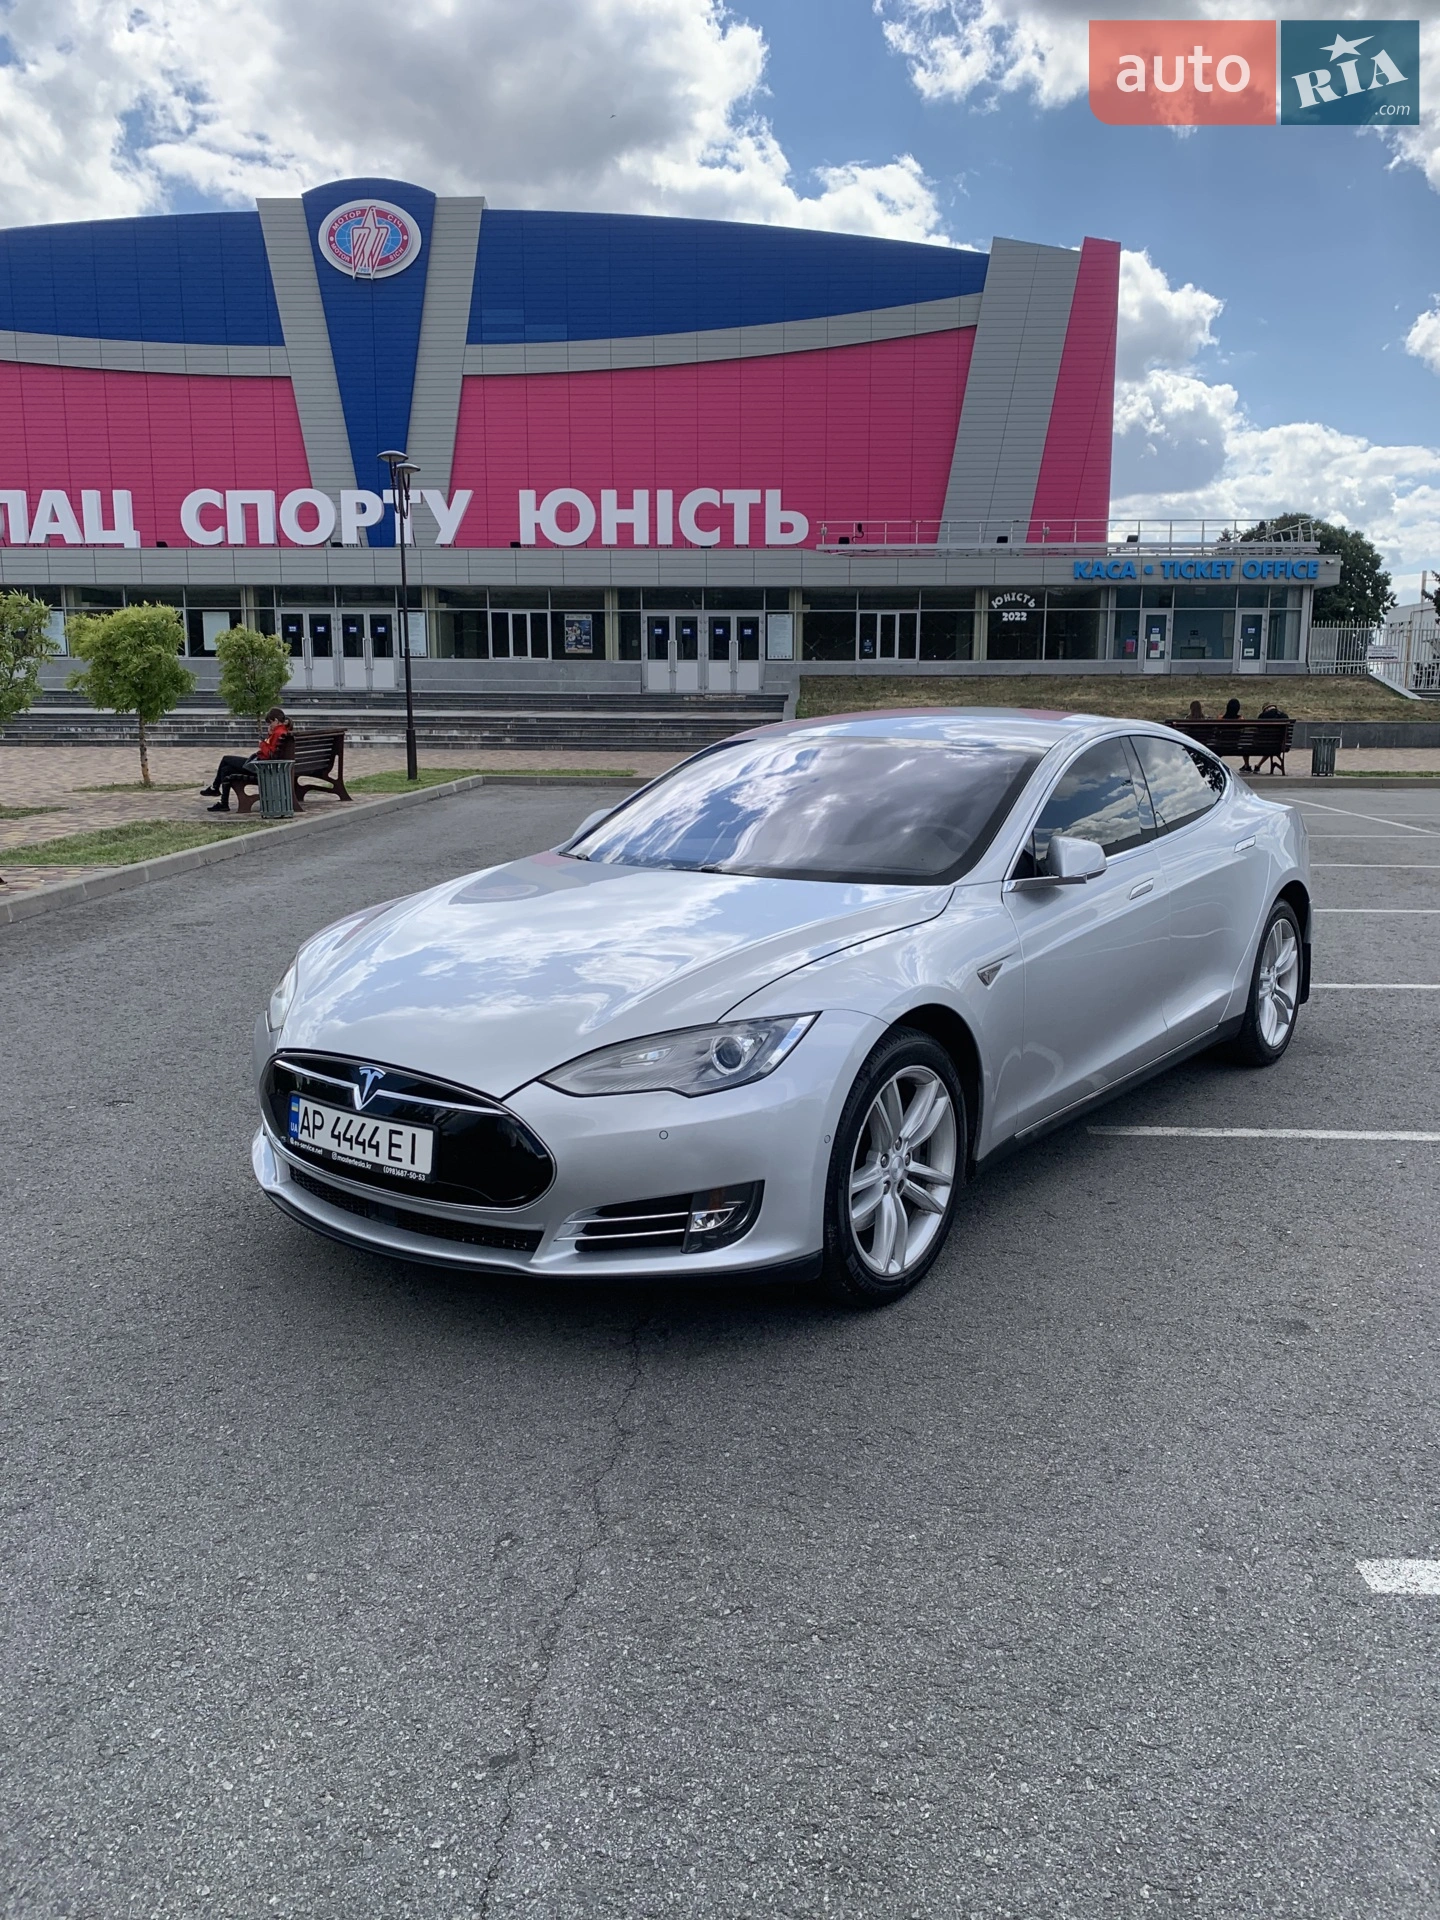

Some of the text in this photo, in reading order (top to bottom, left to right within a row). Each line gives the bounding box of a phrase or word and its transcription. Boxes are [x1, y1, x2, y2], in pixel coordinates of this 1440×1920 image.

[332, 210, 403, 231] МОТОР СІЧ
[330, 243, 404, 262] MOTOR SICH
[180, 488, 474, 546] СПОРТУ
[519, 487, 809, 546] ЮНІСТЬ
[1074, 560, 1319, 579] КАСА TICKET OFFICE
[991, 592, 1036, 609] ЮНІСТЬ
[1002, 611, 1027, 621] 2022
[290, 1121, 298, 1132] UA
[300, 1106, 417, 1165] AP 4444 EI
